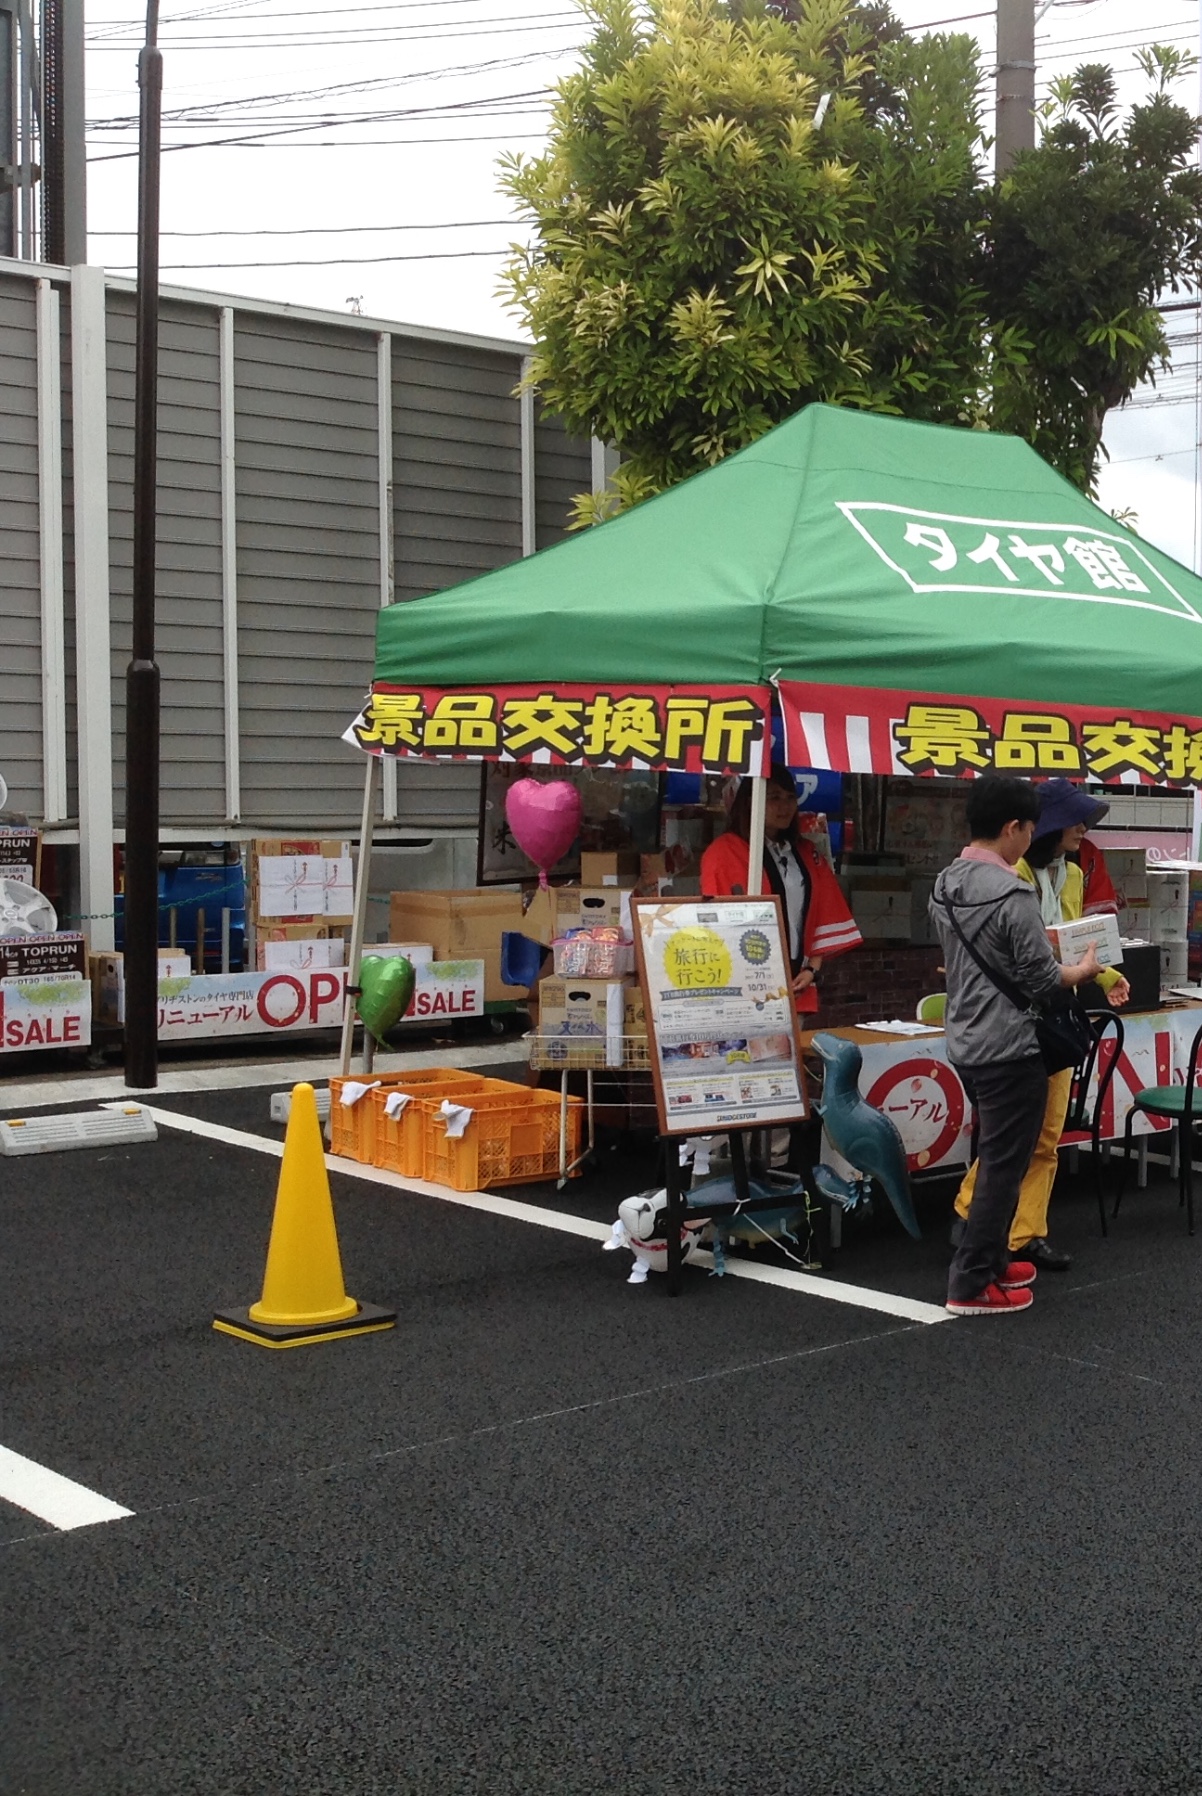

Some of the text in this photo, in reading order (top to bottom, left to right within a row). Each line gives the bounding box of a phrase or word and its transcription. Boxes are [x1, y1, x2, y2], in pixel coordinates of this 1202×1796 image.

[903, 521, 1151, 594] タイヤ館
[358, 694, 755, 763] 景品交換所
[0, 838, 31, 849] RUN
[21, 944, 78, 957] TOPRUN
[674, 948, 720, 966] 旅行に
[677, 968, 722, 986] 行こう!
[158, 990, 253, 1005] リヂストンのタイヤ専門店
[417, 990, 475, 1014] SALE
[6, 1016, 80, 1046] SALE
